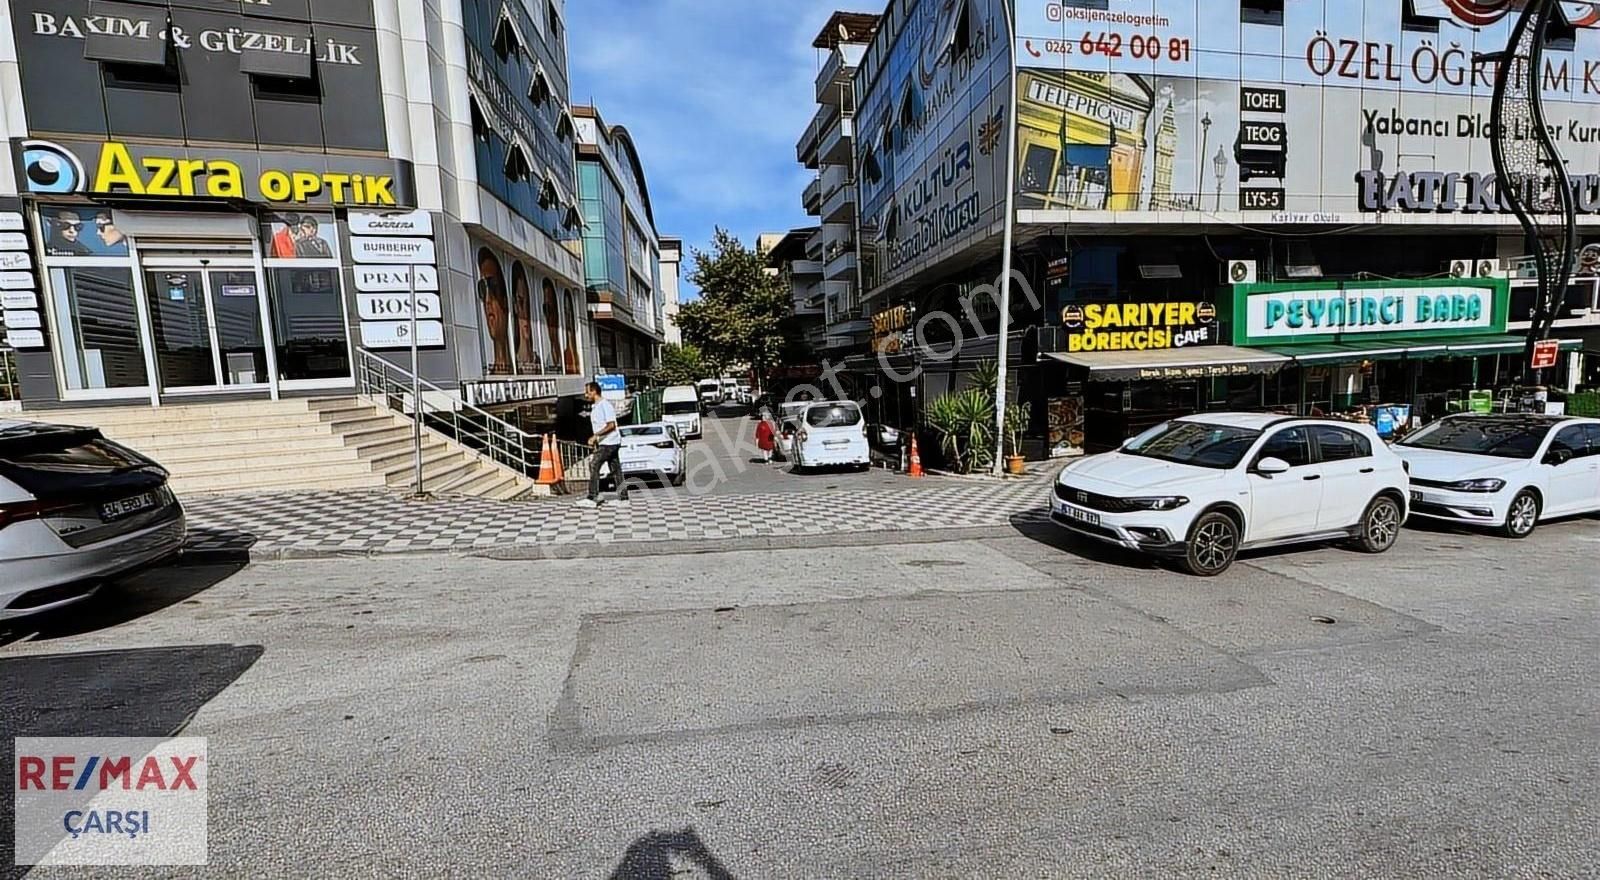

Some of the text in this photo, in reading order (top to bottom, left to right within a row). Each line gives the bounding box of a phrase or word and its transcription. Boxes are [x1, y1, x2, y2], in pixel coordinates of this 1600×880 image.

[32, 12, 150, 39] BAKIM
[159, 26, 192, 48] &
[1045, 31, 1190, 61] 0262 642 00 81
[1307, 30, 1401, 81] ÖZEL
[1034, 82, 1131, 128] TELEPHONE
[1245, 92, 1282, 109] TOEFL
[1246, 126, 1280, 141] TEOG
[1362, 109, 1448, 137] Yabancı
[94, 141, 243, 198] Azra
[904, 141, 971, 218] KÜLTÜR
[1245, 191, 1279, 206] LYS-5
[363, 243, 421, 252] BURBERRY
[371, 298, 430, 314] BOSS
[1084, 302, 1195, 328] SARIYER
[1414, 294, 1482, 323] BABA
[1069, 326, 1208, 351] BÖREKÇİSİ CAFE
